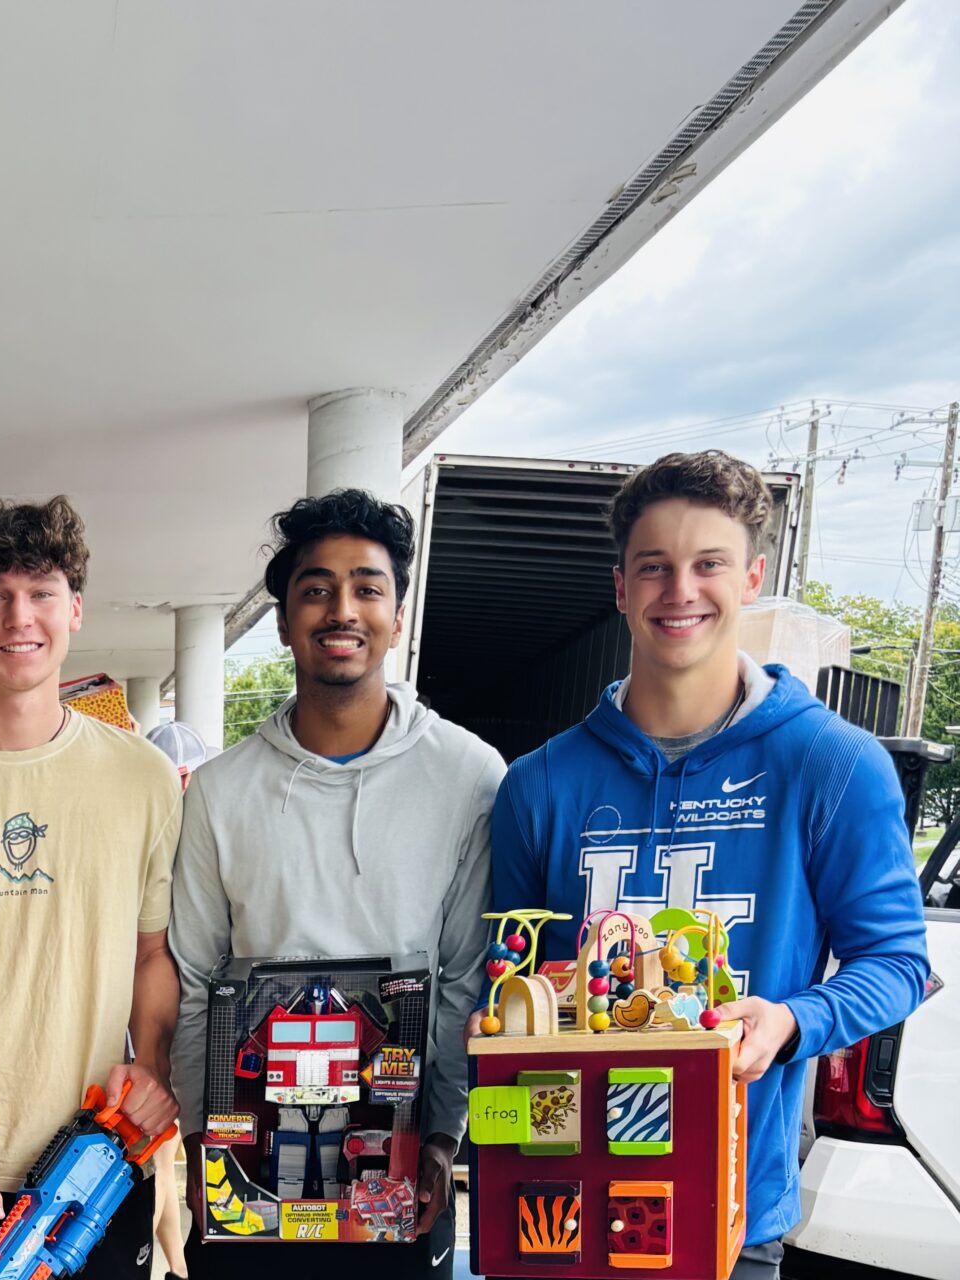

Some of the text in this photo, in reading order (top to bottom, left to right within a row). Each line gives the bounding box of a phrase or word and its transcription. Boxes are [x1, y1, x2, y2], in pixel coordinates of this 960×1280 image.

[670, 796, 767, 810] KENTUCKY
[602, 922, 629, 942] zany
[381, 1047, 416, 1062] TRY
[381, 1061, 414, 1075] ME!
[207, 1114, 253, 1122] CONVERTS
[483, 1106, 518, 1125] frog
[296, 1223, 325, 1239] R/C
